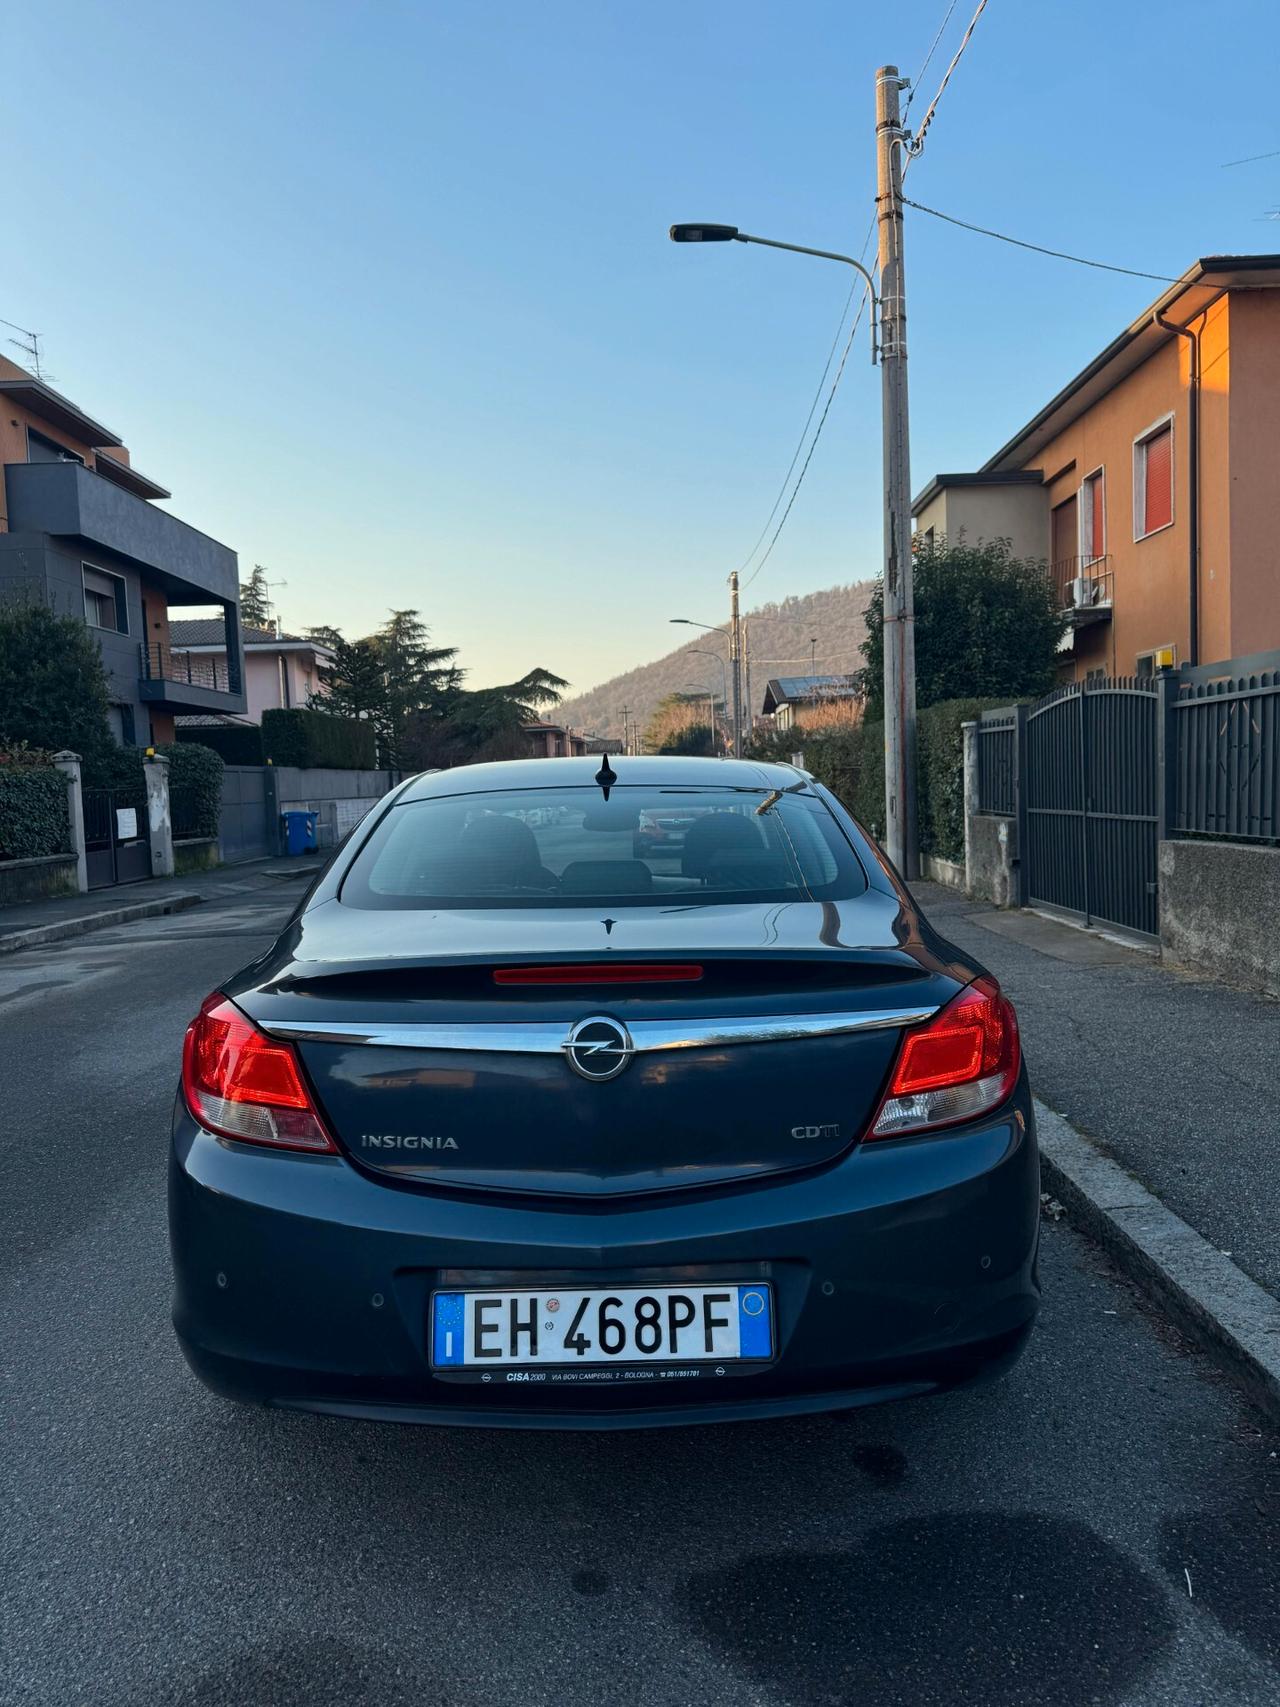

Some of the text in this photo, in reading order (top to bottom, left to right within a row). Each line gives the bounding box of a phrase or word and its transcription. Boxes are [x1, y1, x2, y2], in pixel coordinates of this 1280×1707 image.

[361, 1135, 459, 1149] INSIGNIA
[474, 1293, 731, 1358] EH 468PF
[506, 1372, 530, 1382] CISA
[551, 1373, 562, 1381] VIA
[624, 1371, 654, 1379] BOLOGNA
